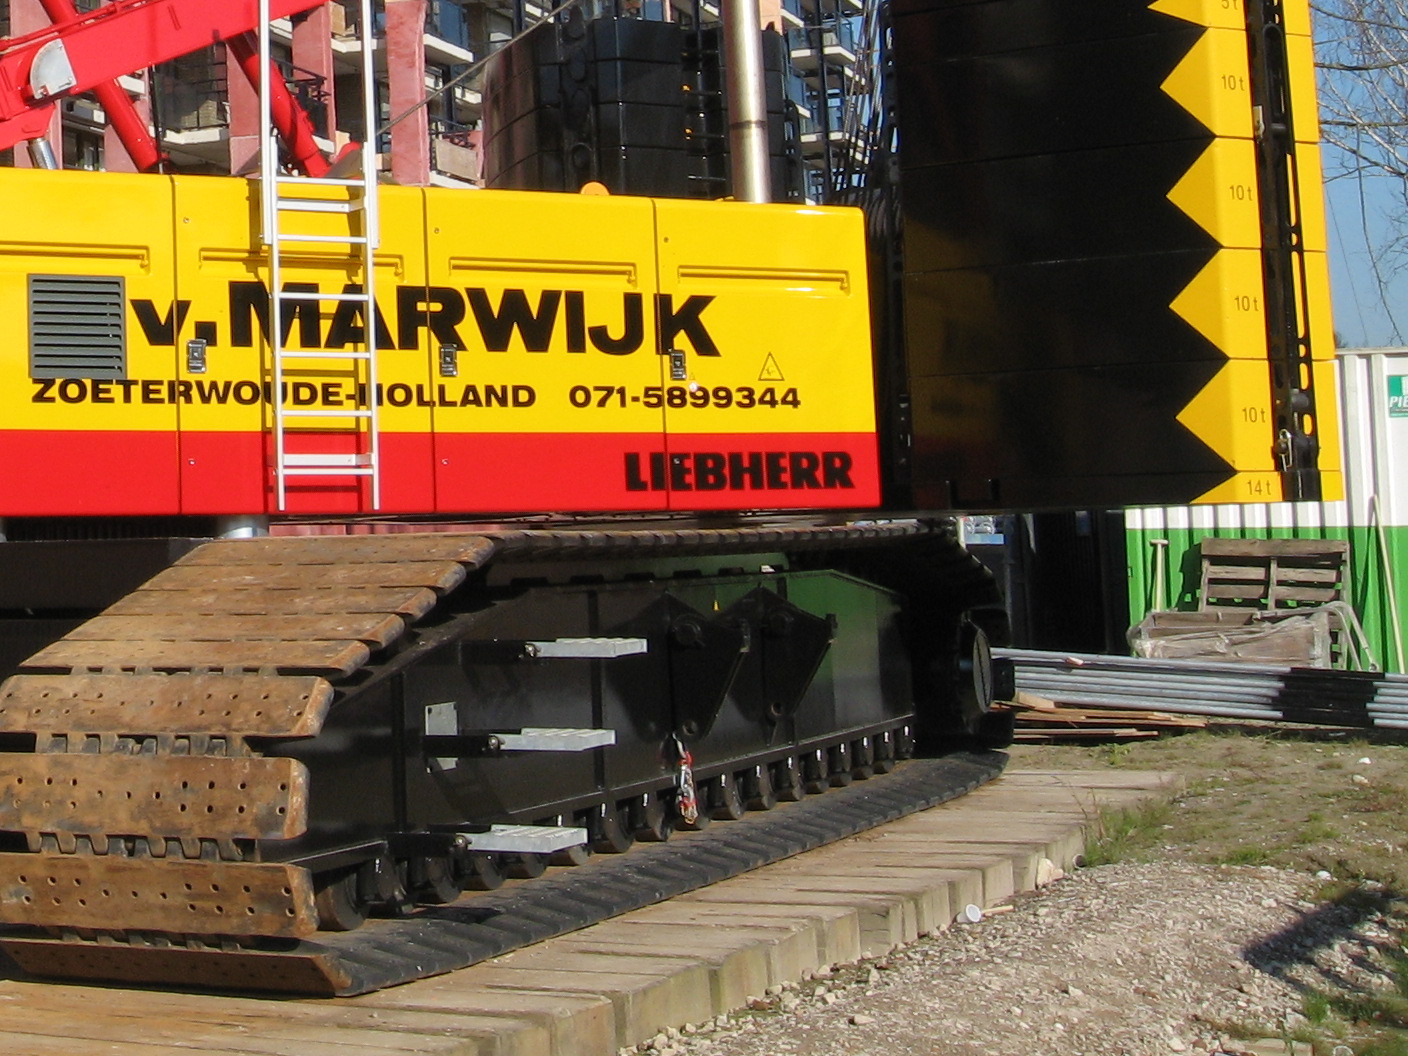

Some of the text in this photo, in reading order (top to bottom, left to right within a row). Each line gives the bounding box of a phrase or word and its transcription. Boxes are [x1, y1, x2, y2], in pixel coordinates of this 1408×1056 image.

[1221, 75, 1245, 91] 10 t
[1229, 185, 1253, 201] 10 t
[1234, 296, 1259, 311] 10 t
[31, 377, 801, 408] ZOETERWOUDE-HOLLAND 071-5899344
[1242, 407, 1266, 423] 10 t
[624, 451, 855, 491] LIEBHERR
[1247, 480, 1271, 496] 14 t
